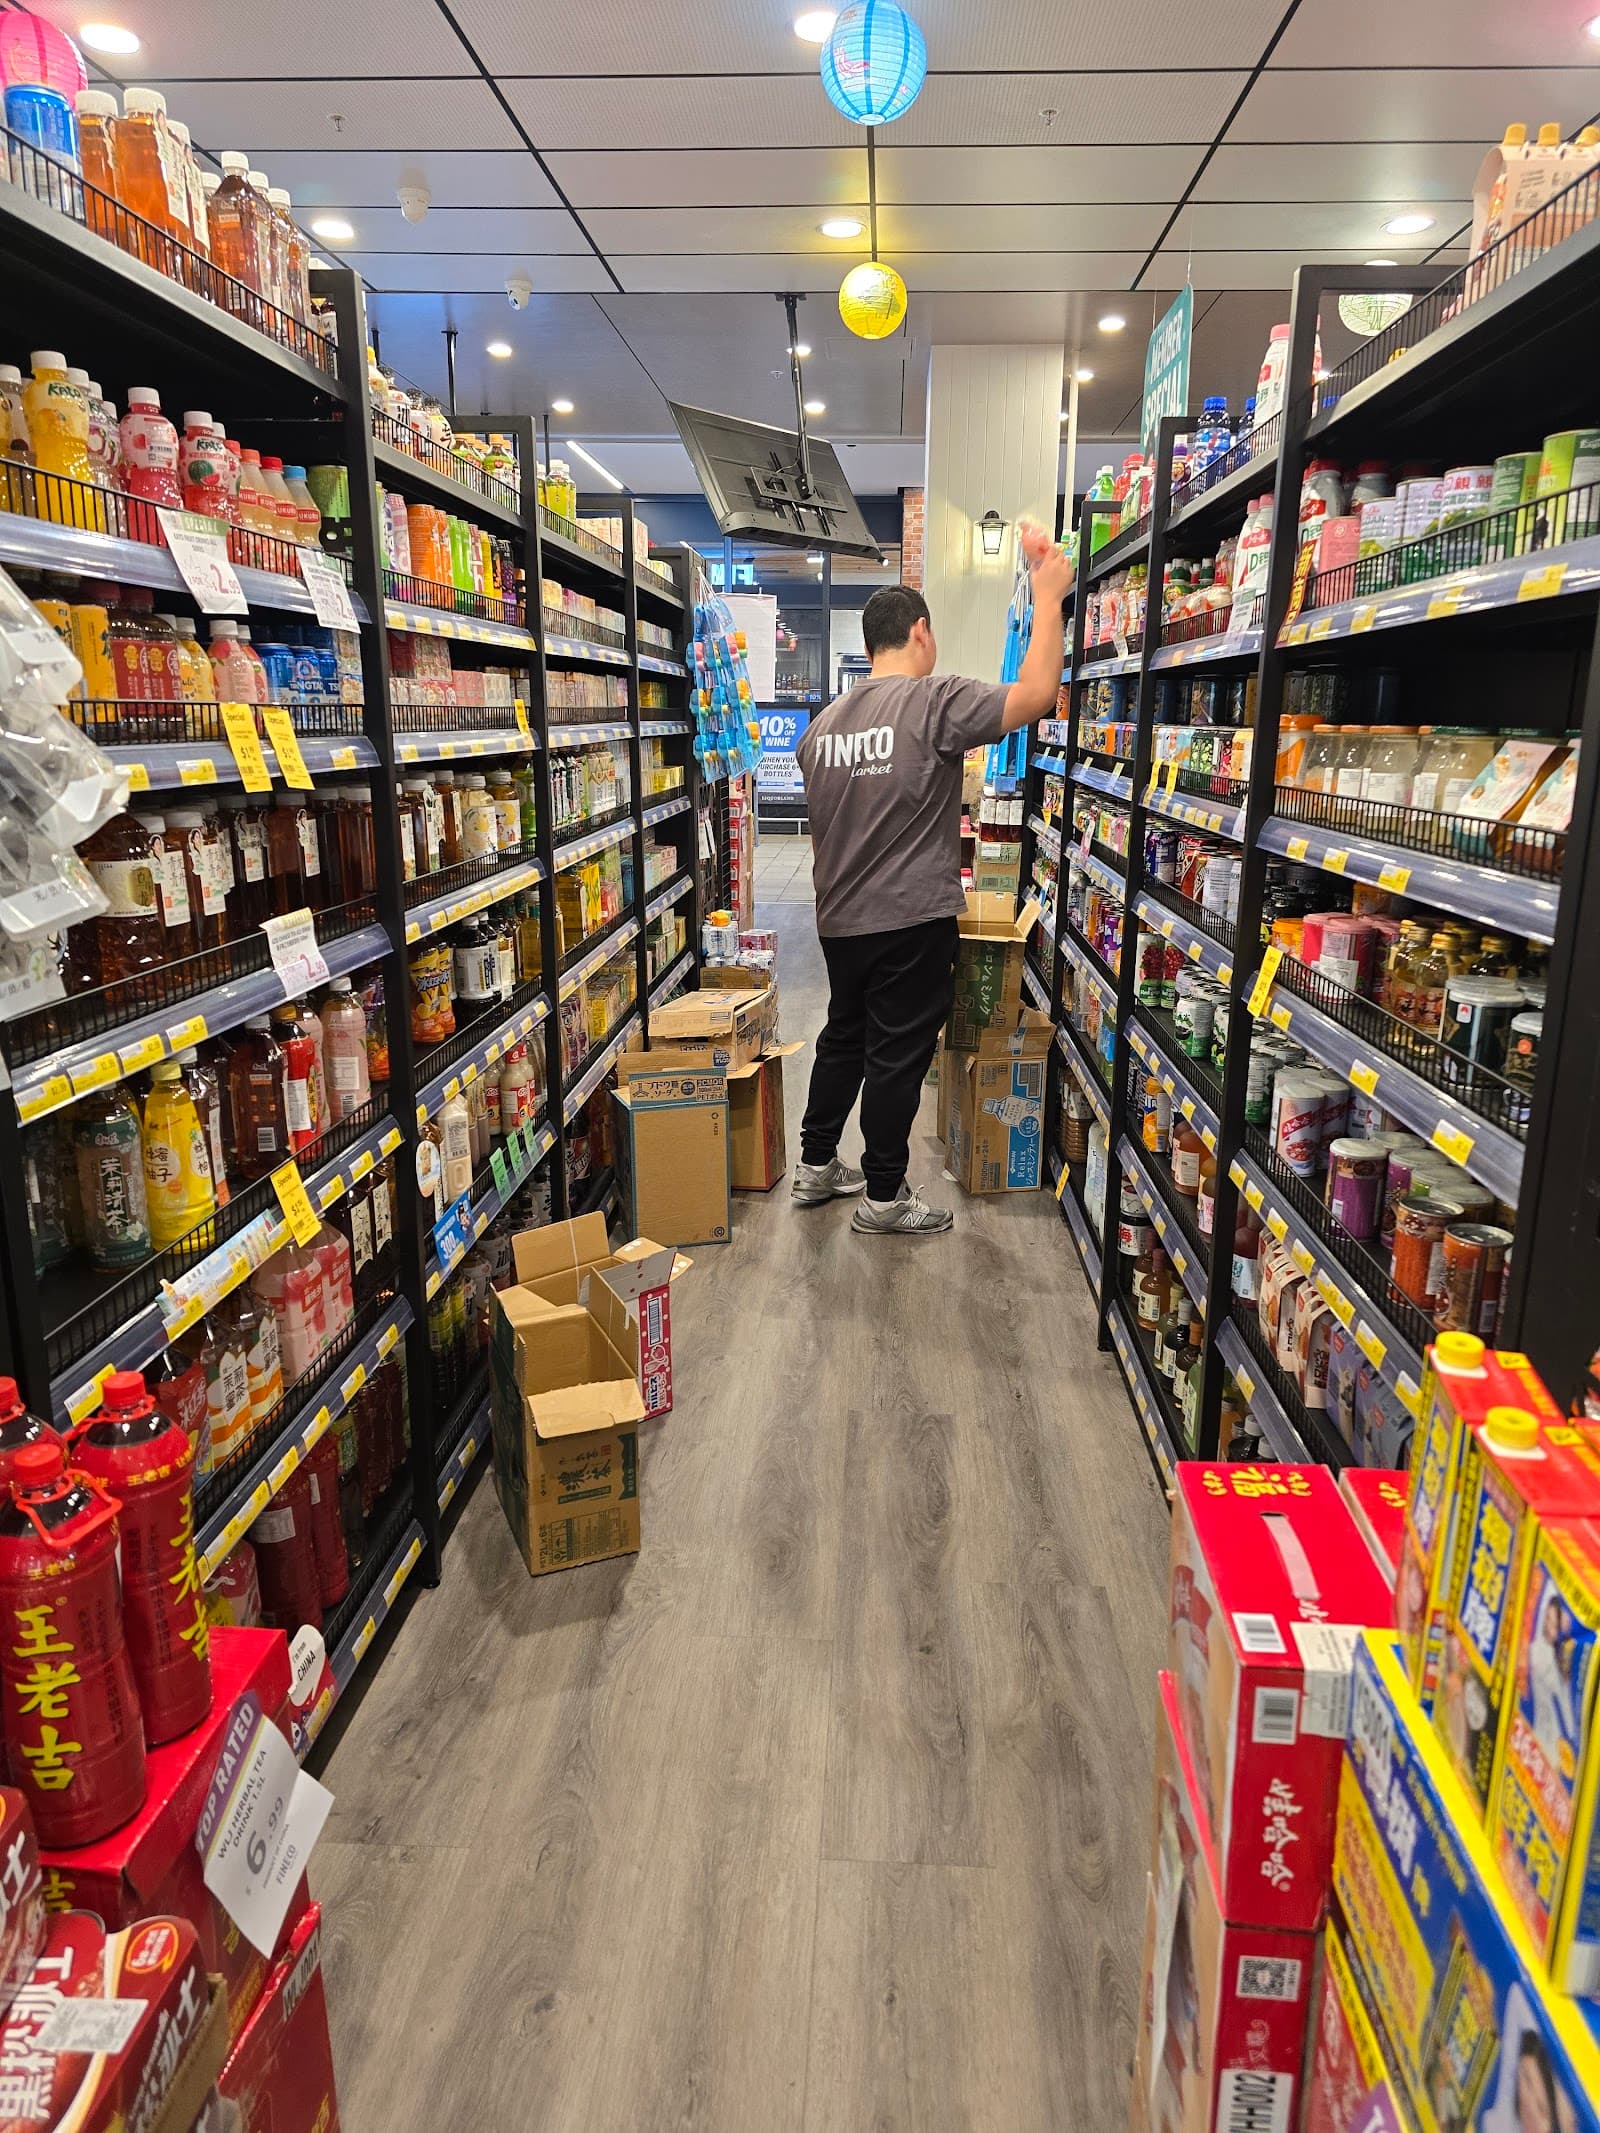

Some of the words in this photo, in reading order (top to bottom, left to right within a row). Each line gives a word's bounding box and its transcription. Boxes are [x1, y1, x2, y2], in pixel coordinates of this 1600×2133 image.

[1150, 308, 1183, 385] MEMBER
[1144, 360, 1182, 448] SPECIAL
[759, 716, 796, 736] 10%
[765, 737, 791, 747] WINE
[1017, 1150, 1025, 1178] Relax
[1026, 1137, 1037, 1185] ジャスミンティー
[297, 1650, 316, 1681] CHINA
[13, 1604, 83, 1791] 王老吉
[195, 1791, 217, 1851] TOP
[215, 1702, 255, 1793] RATED
[218, 1829, 235, 1859] WLJ
[231, 1777, 258, 1831] HERBAL
[252, 1750, 267, 1776] TEA
[233, 1804, 255, 1848] DRINK
[1261, 1777, 1304, 1888] 娃哈哈
[276, 1843, 297, 1885] FINECO
